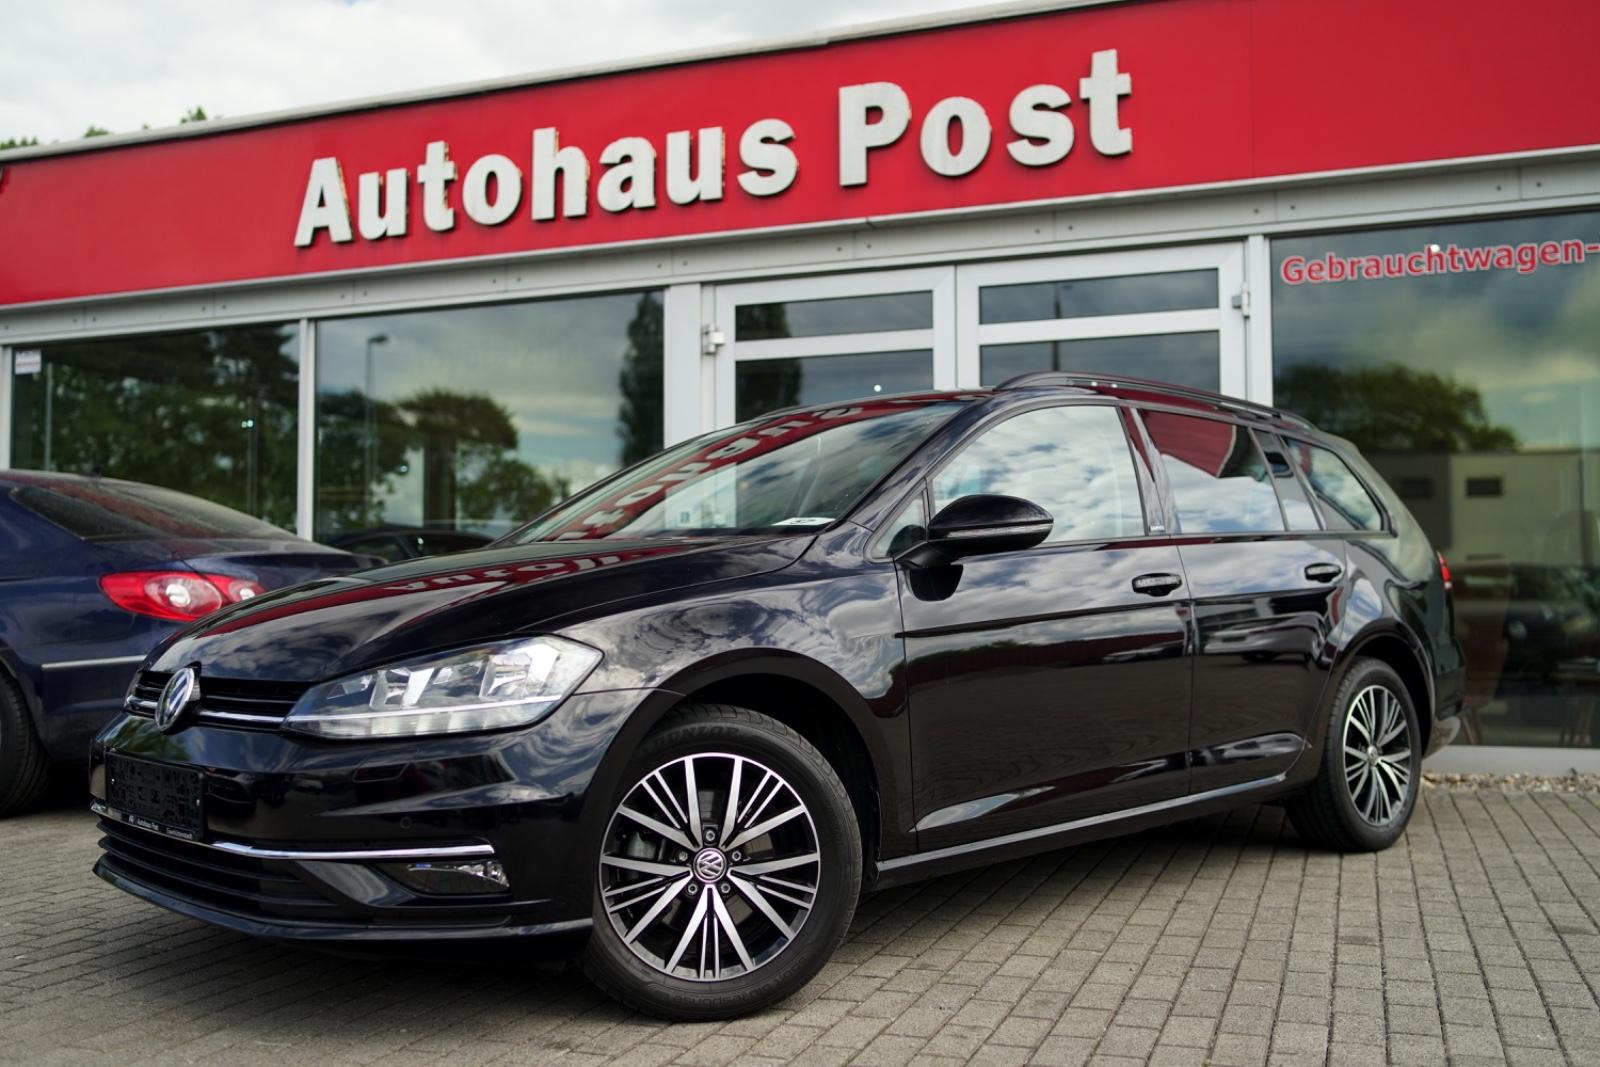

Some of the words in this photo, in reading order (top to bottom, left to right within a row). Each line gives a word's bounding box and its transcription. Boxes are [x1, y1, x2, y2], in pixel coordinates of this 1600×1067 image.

[294, 119, 800, 247] Autohaus
[838, 49, 1134, 187] Post
[1279, 238, 1600, 285] Gebrauchtwagen-
